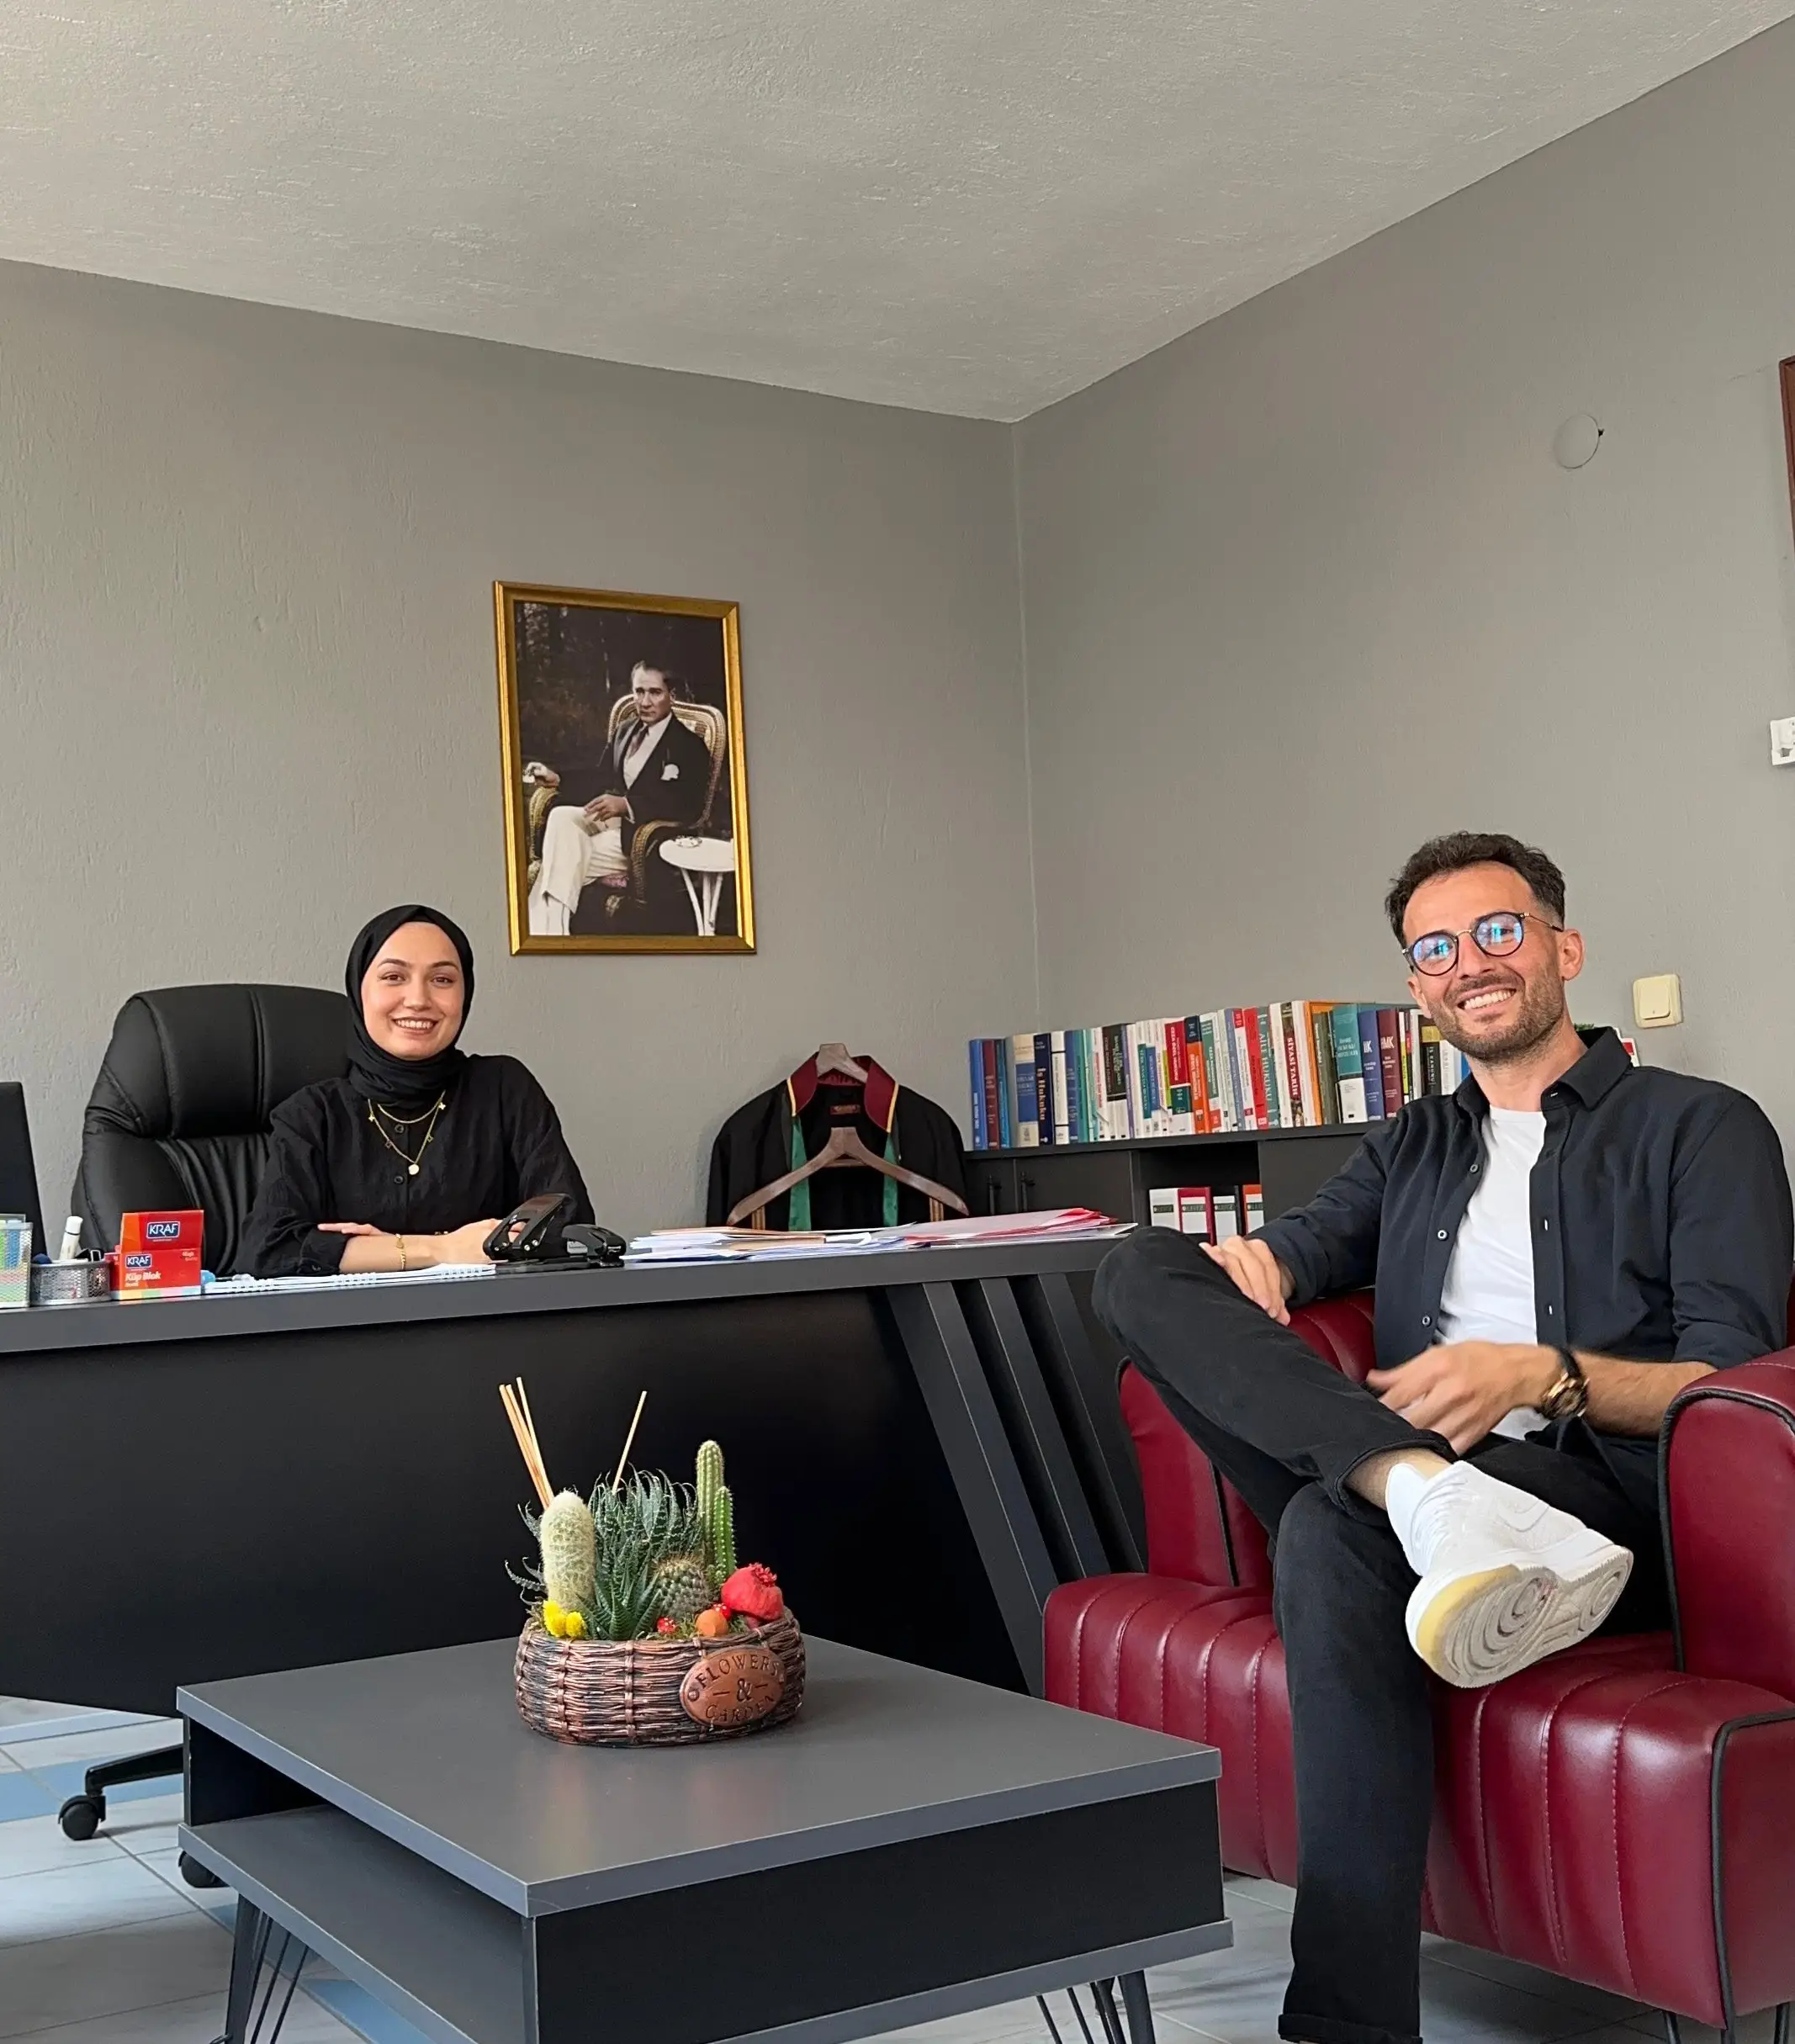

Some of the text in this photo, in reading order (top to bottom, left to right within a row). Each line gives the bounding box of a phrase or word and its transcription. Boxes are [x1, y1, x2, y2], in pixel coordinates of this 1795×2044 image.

[1038, 1080, 1047, 1120] Hukuku
[149, 1223, 178, 1236] KRAF
[127, 1256, 151, 1267] KRAF
[695, 1654, 781, 1689] FLOWERS
[736, 1678, 752, 1702] &
